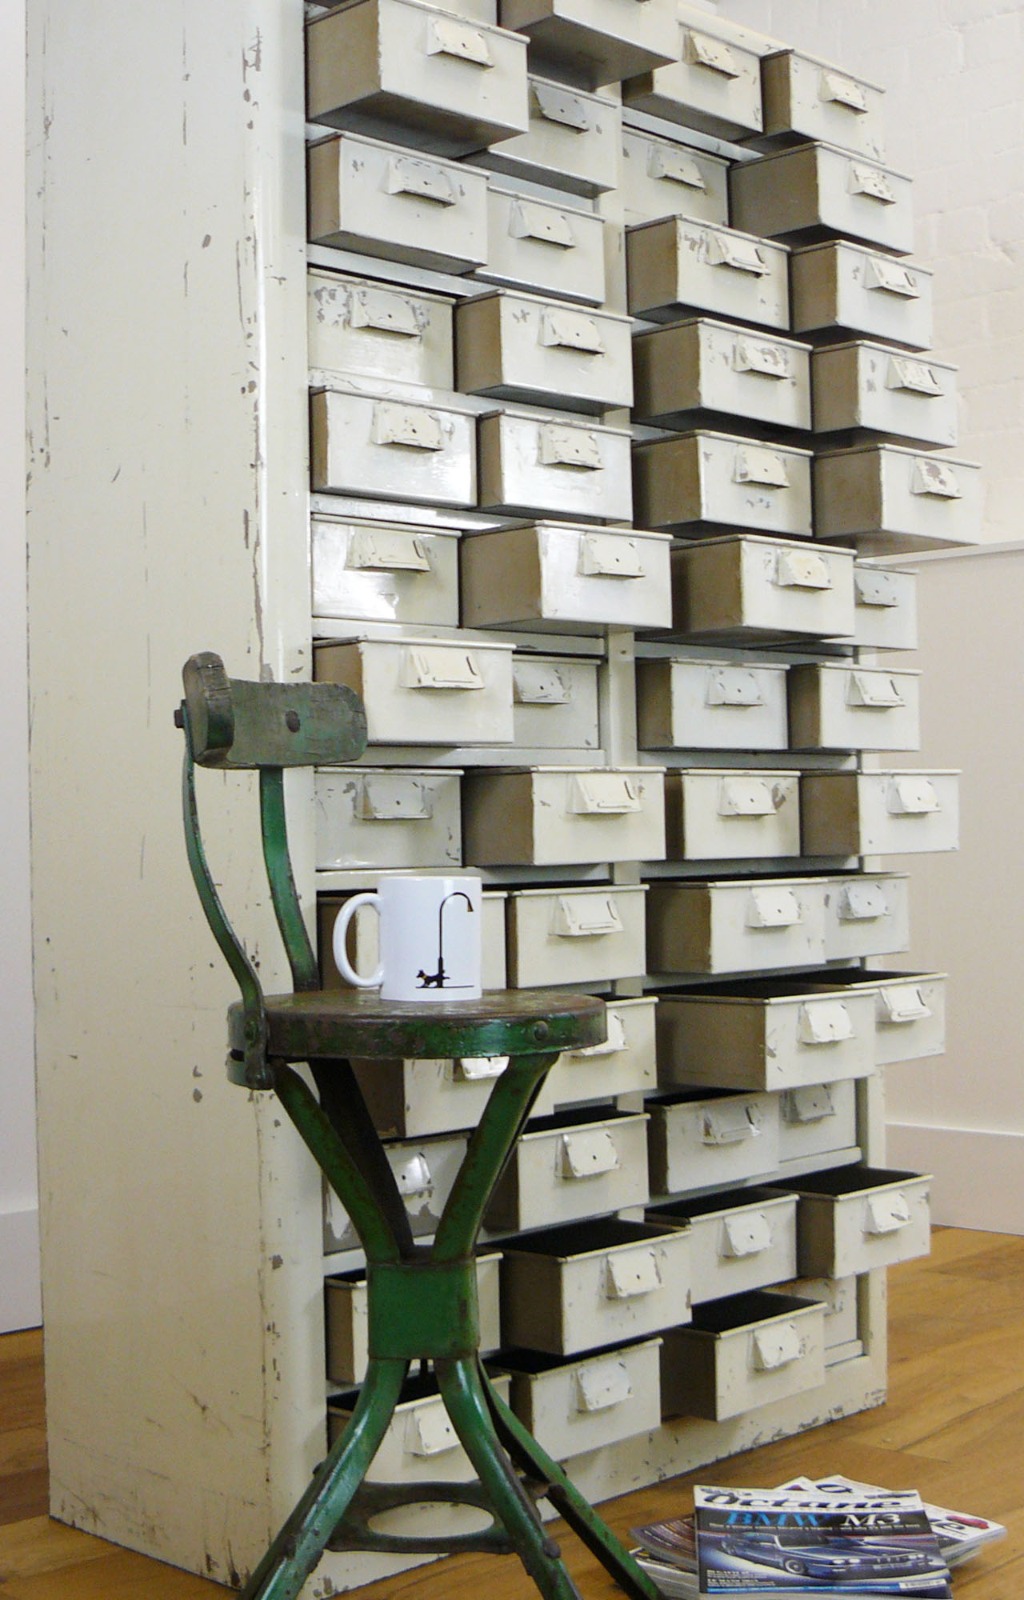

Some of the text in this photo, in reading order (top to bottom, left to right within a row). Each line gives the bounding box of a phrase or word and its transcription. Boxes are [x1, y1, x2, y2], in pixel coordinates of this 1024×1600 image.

[704, 1493, 915, 1509] Octane
[726, 1510, 831, 1527] BMW
[842, 1513, 901, 1527] M3
